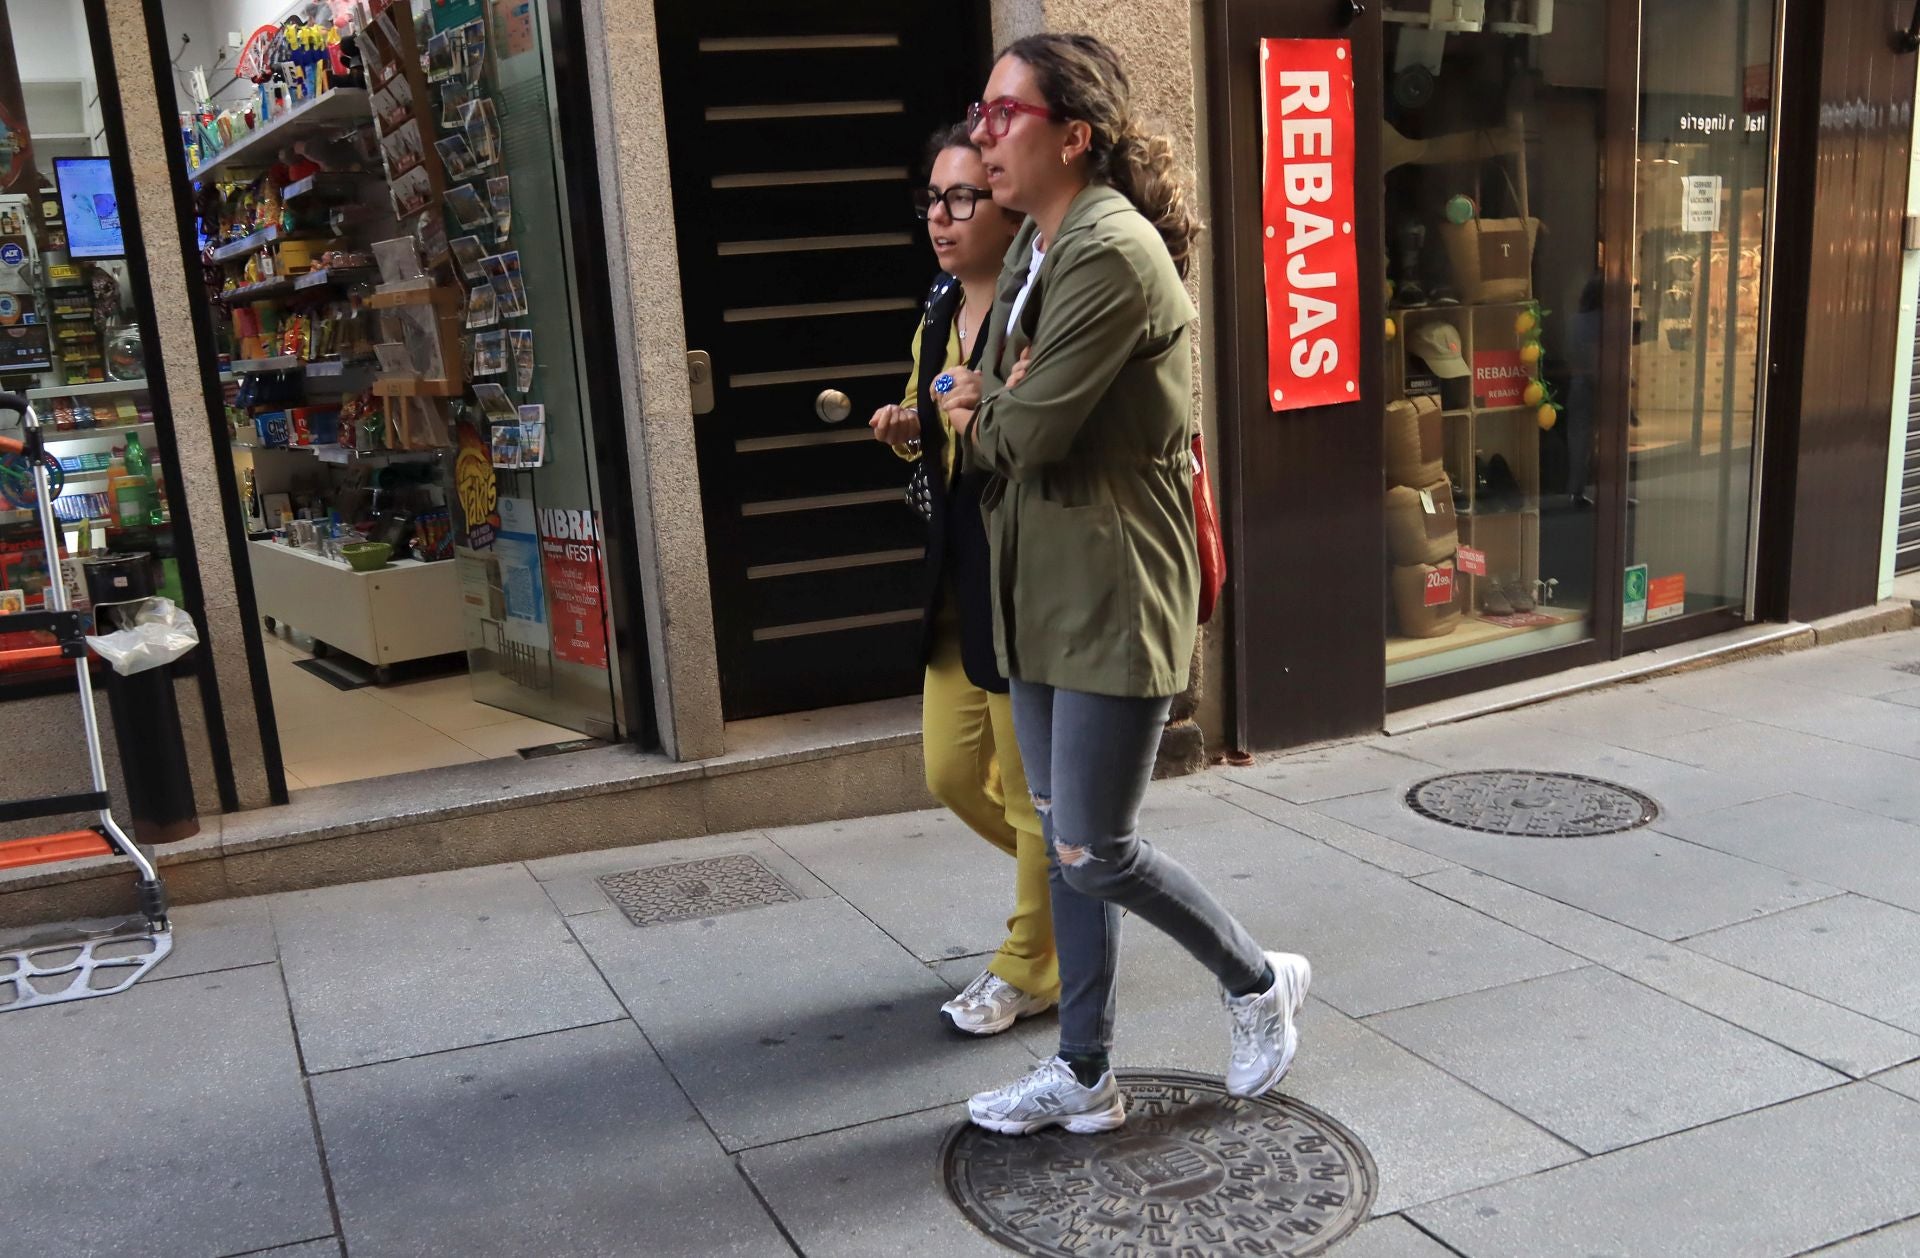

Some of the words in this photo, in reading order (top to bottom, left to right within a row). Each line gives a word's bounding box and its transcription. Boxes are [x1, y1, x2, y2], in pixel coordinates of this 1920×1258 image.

[1280, 71, 1339, 379] REBAJAS
[1477, 366, 1527, 379] REBAJAS
[1489, 389, 1519, 398] REBAJAS
[459, 469, 497, 535] Takis
[1032, 1090, 1066, 1113] N
